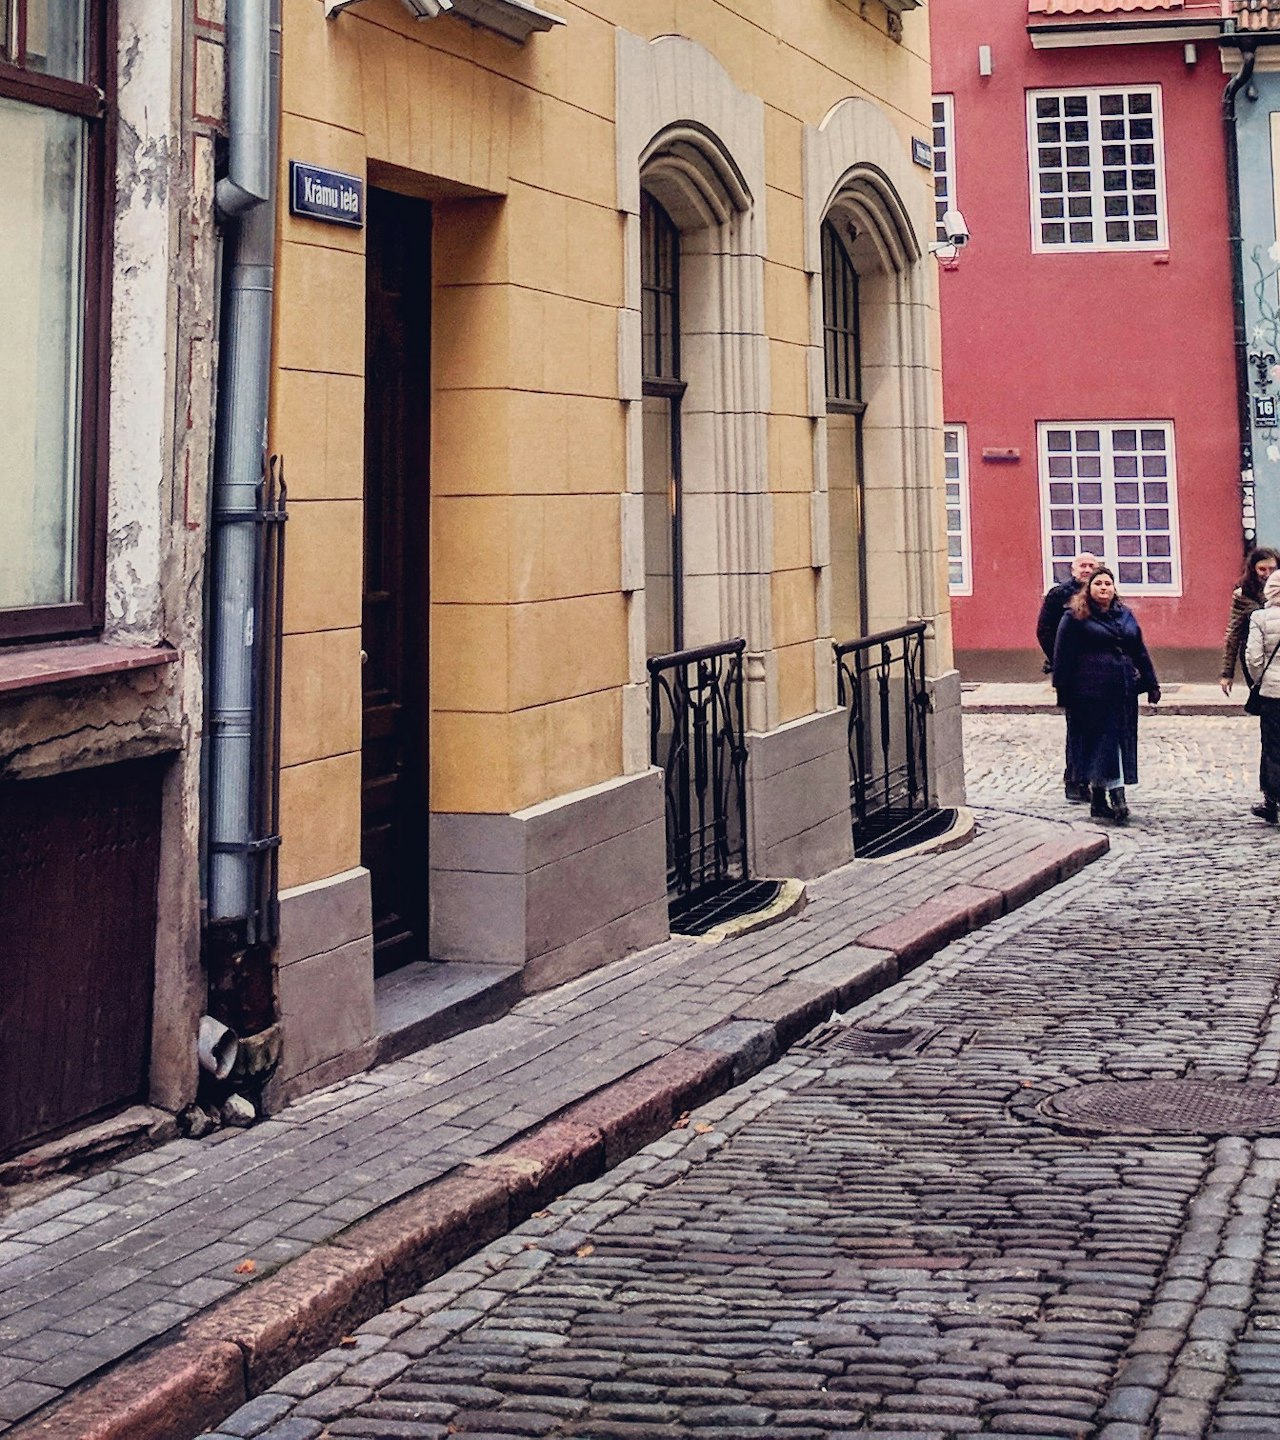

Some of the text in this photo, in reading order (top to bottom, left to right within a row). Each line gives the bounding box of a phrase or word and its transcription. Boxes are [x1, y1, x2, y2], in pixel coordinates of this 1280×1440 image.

[304, 176, 359, 213] Krāmu iela
[1257, 401, 1274, 416] 16
